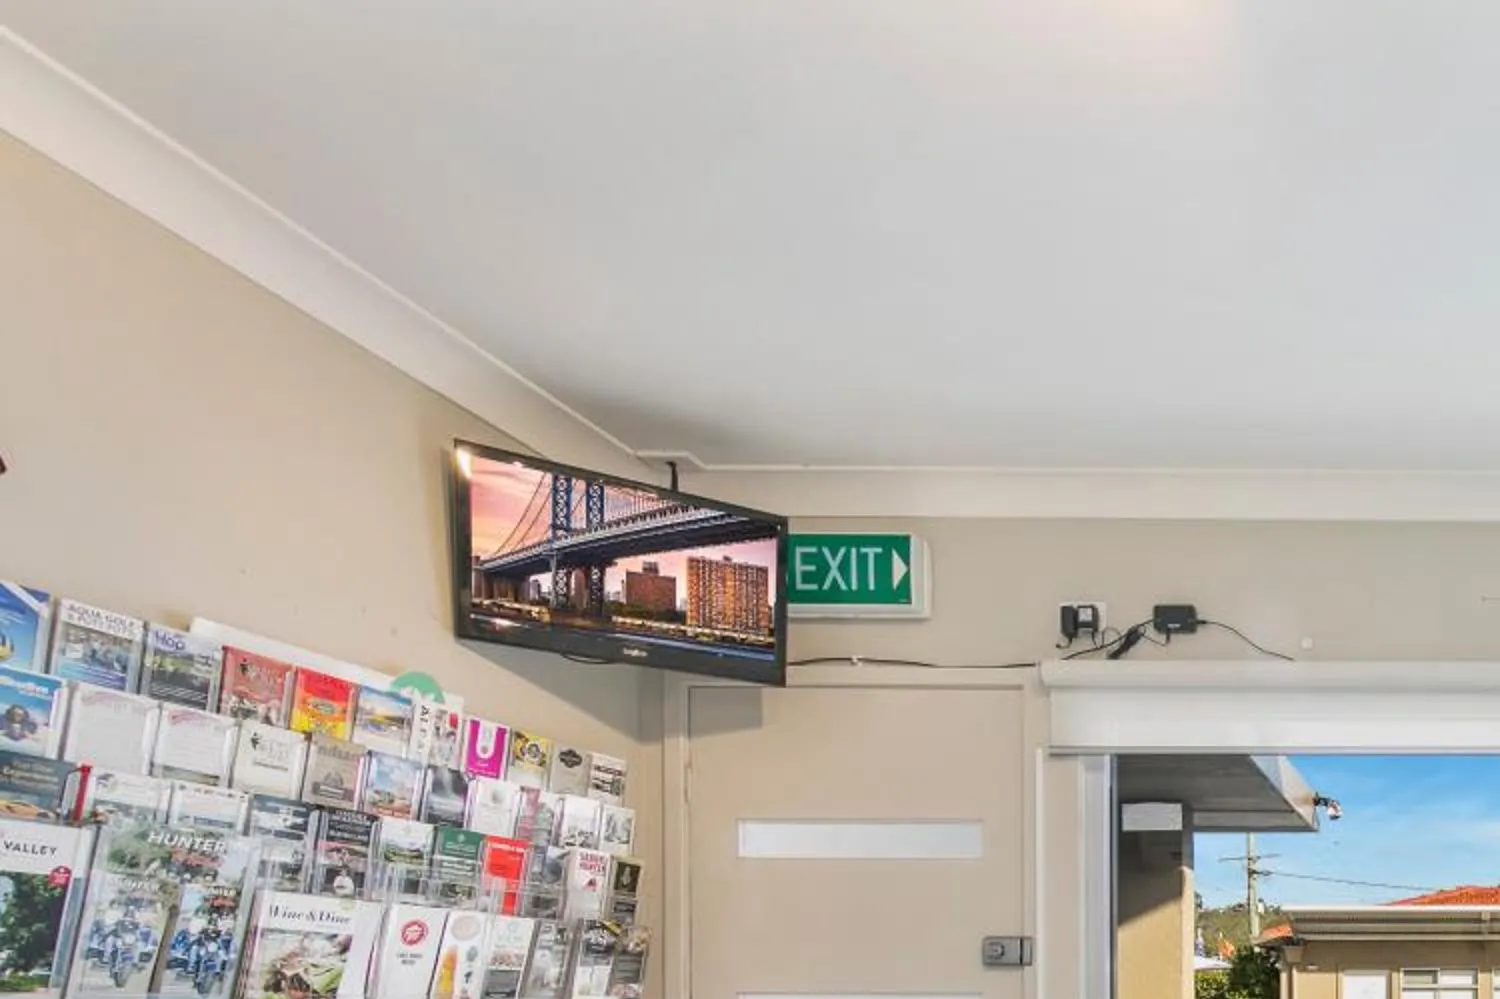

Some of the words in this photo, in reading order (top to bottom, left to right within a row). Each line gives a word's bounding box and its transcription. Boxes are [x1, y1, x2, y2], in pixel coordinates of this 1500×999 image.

[795, 545, 883, 591] EXIT
[3, 839, 57, 855] VALLEY
[148, 830, 227, 854] HUNTER
